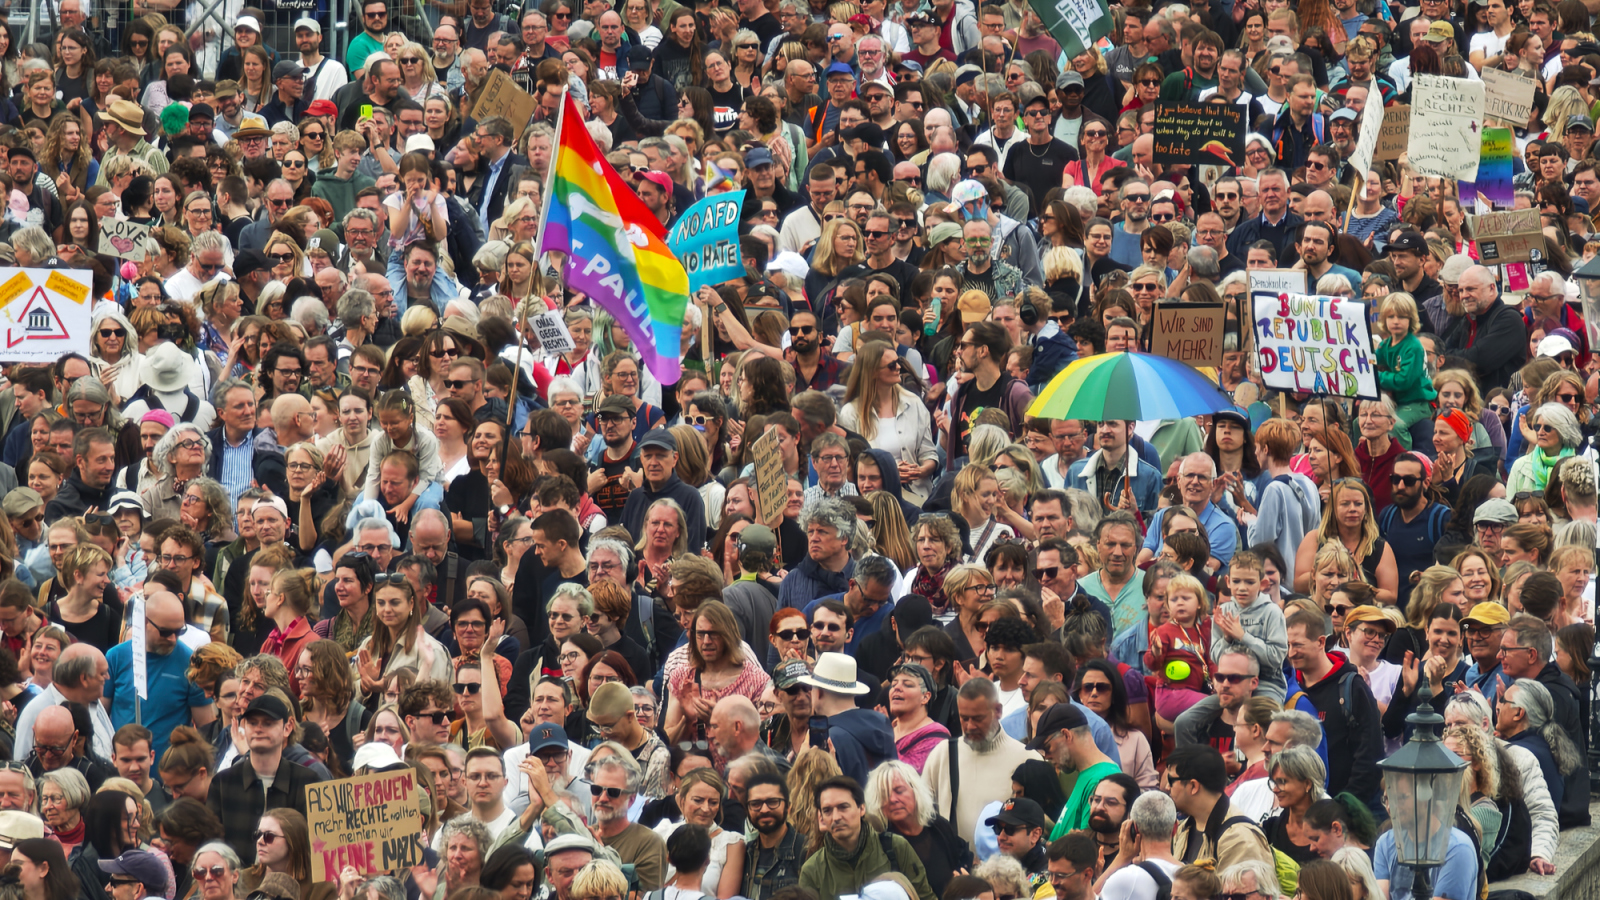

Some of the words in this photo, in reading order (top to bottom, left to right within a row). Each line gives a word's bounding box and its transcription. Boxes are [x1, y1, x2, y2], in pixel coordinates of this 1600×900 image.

[1177, 104, 1202, 114] believe
[1205, 105, 1220, 116] that
[1223, 105, 1241, 124] they
[1424, 98, 1476, 115] RECHTS
[1156, 126, 1174, 134] when
[1176, 126, 1190, 141] they
[1192, 127, 1201, 135] do
[1203, 128, 1210, 136] it
[1212, 128, 1227, 137] will
[1197, 117, 1213, 126] hurt
[1155, 141, 1168, 153] too
[1169, 141, 1191, 156] late
[101, 221, 147, 247] LOVE
[676, 212, 700, 245] NO
[701, 201, 738, 233] AFD
[702, 239, 737, 271] HATE
[582, 253, 657, 347] PAUL
[1277, 292, 1342, 320] BUNTE
[535, 317, 555, 328] OMAS
[539, 328, 562, 339] GEGEN
[1160, 310, 1185, 334] WIR
[1191, 316, 1214, 333] SIND
[1257, 317, 1360, 347] REPUBLIK
[542, 338, 569, 350] RECHTS
[1166, 337, 1213, 360] MEHR!
[1294, 369, 1358, 397] LAND
[308, 784, 333, 813] ALS
[332, 782, 355, 814] WIR
[354, 772, 413, 808] FRAUEN
[314, 813, 343, 836] mehr
[345, 804, 389, 830] RECHTE
[339, 828, 377, 843] meinten
[379, 827, 393, 838] wir
[323, 841, 378, 882] KEINE
[382, 831, 424, 870] NAZIS
